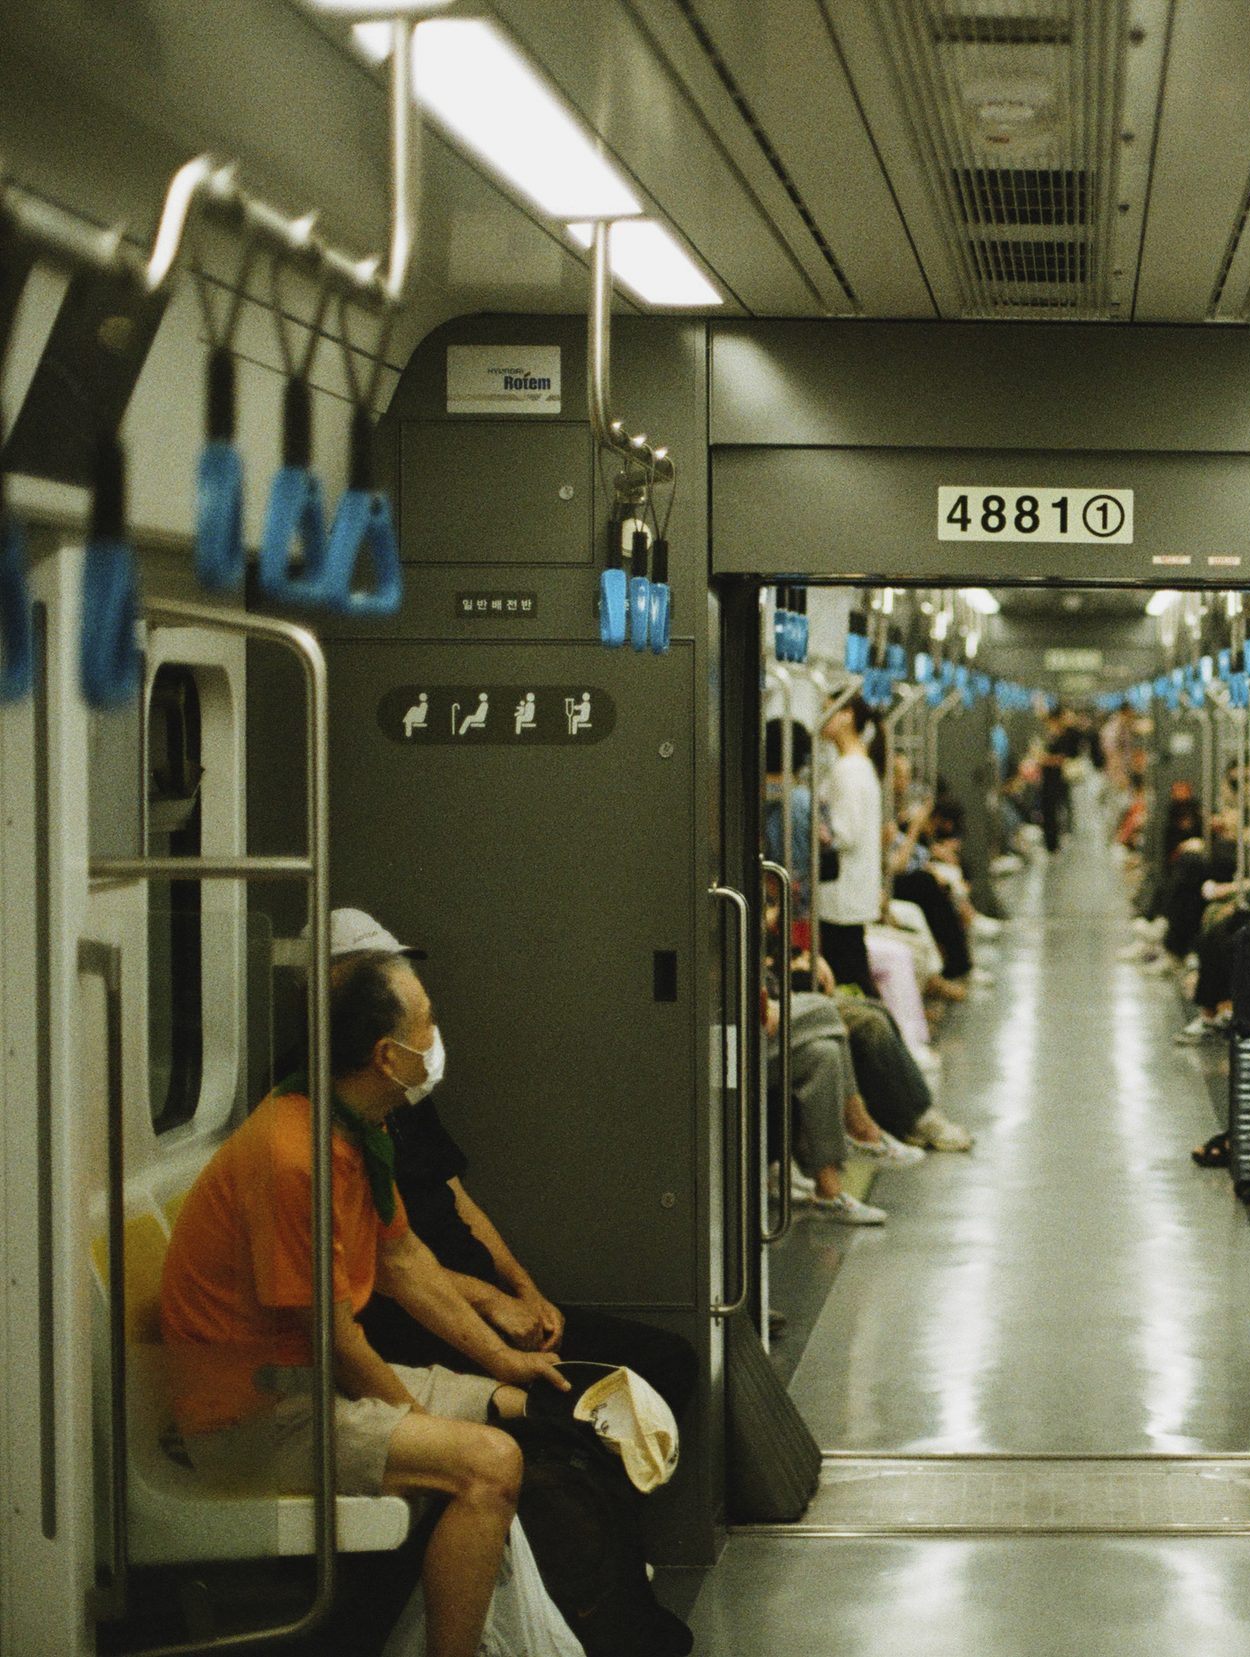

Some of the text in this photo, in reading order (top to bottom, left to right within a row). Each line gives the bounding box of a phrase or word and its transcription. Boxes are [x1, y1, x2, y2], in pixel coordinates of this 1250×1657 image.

[503, 372, 551, 390] Rotem
[946, 494, 1068, 534] 4881
[462, 599, 532, 611] 일반배전반
